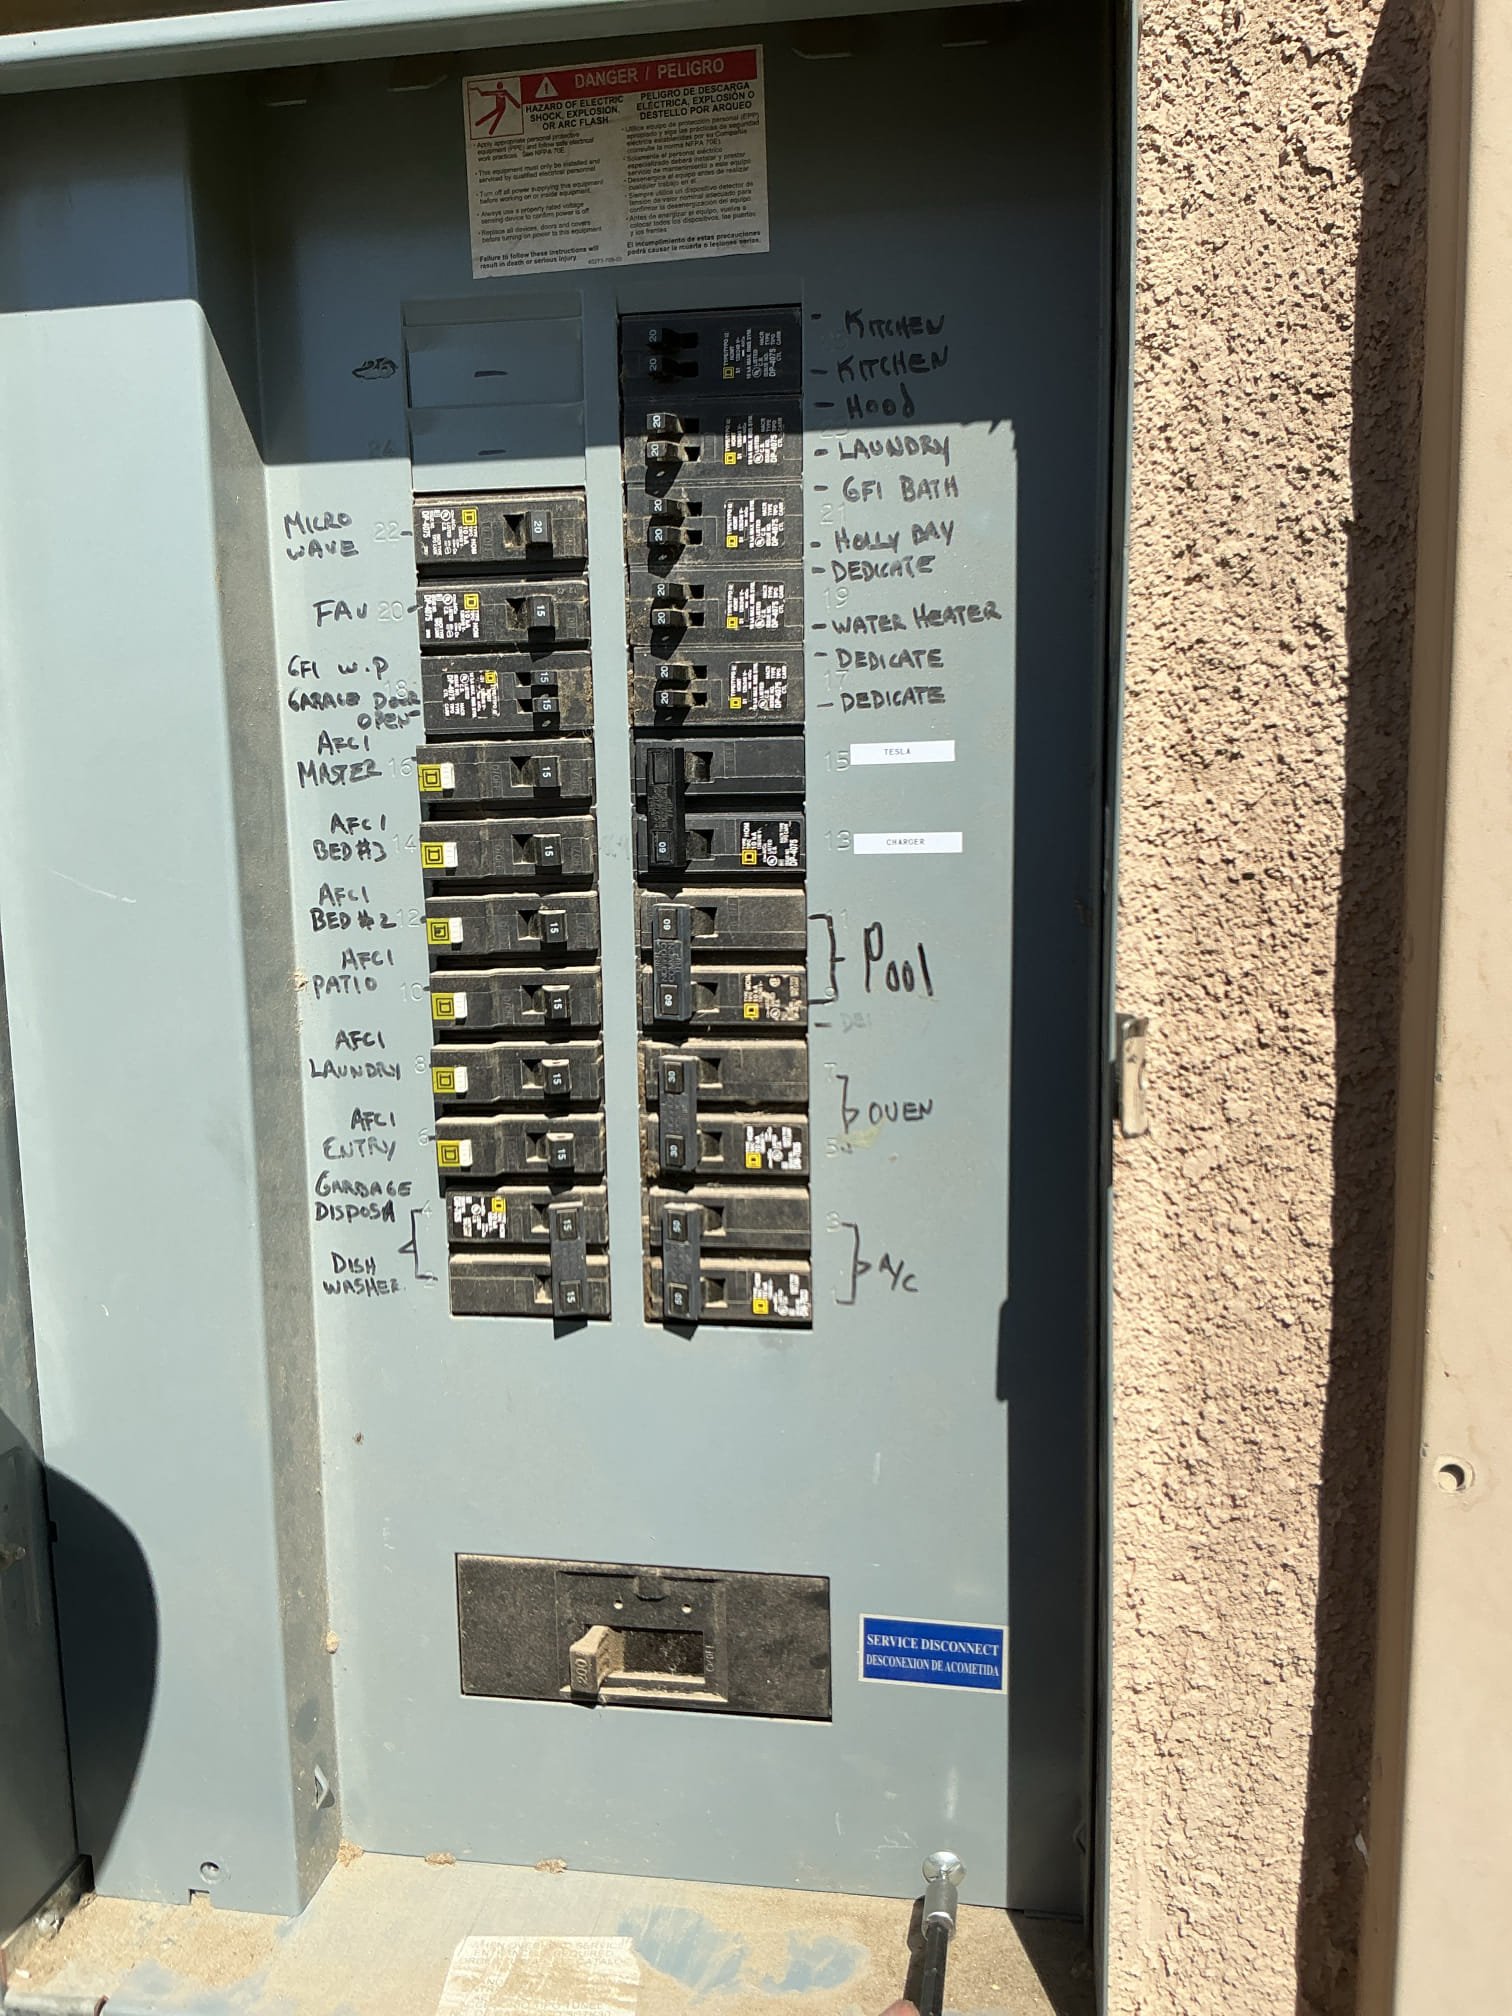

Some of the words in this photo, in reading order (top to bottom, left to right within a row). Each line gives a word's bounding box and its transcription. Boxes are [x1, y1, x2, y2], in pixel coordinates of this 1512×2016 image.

[574, 67, 638, 88] DANGER
[657, 57, 725, 79] PELIGRO
[640, 89, 680, 100] PELIGRO
[683, 87, 696, 96] DE
[698, 81, 749, 94] DESCARGA
[747, 90, 754, 98] O
[525, 101, 562, 112] HAZARD
[564, 100, 576, 108] OF
[579, 95, 624, 107] ELECTRIC
[639, 107, 687, 119] DESTELLO
[690, 105, 710, 114] POR
[712, 100, 752, 112] ARQUEO
[542, 121, 556, 130] OR
[558, 119, 576, 128] ARC
[579, 116, 609, 126] FLASH
[845, 309, 945, 339] KITCHEN
[650, 330, 657, 342] 20
[650, 358, 657, 371] 20
[837, 346, 949, 383] KITCHEN
[653, 415, 660, 428] 20
[652, 444, 659, 457] 20
[838, 436, 952, 467] LAUNDRY
[900, 473, 960, 501] BATH
[654, 499, 662, 512] 20
[284, 511, 353, 540] MICRO
[534, 520, 542, 534] 20
[654, 528, 663, 542] 20
[831, 555, 937, 583] DEDICATE
[657, 583, 665, 597] 20
[536, 605, 545, 617] 15
[657, 612, 666, 625] 20
[832, 613, 907, 636] WATER
[913, 601, 1003, 626] HEATER
[837, 647, 945, 671] DEDICATE
[540, 672, 548, 684] 15
[660, 665, 668, 679] 20
[542, 700, 550, 710] 15
[661, 692, 669, 706] 20
[841, 686, 946, 713] DEDICATE
[883, 748, 911, 756] TESLA
[297, 758, 383, 789] MASTER
[542, 766, 551, 778] 15
[885, 837, 926, 847] CHARGER
[312, 838, 353, 862] BED
[544, 845, 554, 858] 15
[309, 907, 351, 933] BED
[550, 922, 559, 934] 15
[312, 973, 379, 999] PATIO
[553, 998, 562, 1010] 15
[308, 1057, 402, 1080] LAUNDRY
[553, 1072, 562, 1086] 15
[557, 1148, 566, 1161] 15
[563, 1218, 572, 1232] 15
[331, 1251, 377, 1275] DISH
[567, 1290, 576, 1304] 15
[866, 1633, 919, 1650] SERVICE
[921, 1638, 1000, 1657] DISCONNECT
[866, 1653, 930, 1671] DESCONEXION
[931, 1659, 944, 1672] DE
[945, 1661, 1000, 1677] ACOMETIDA
